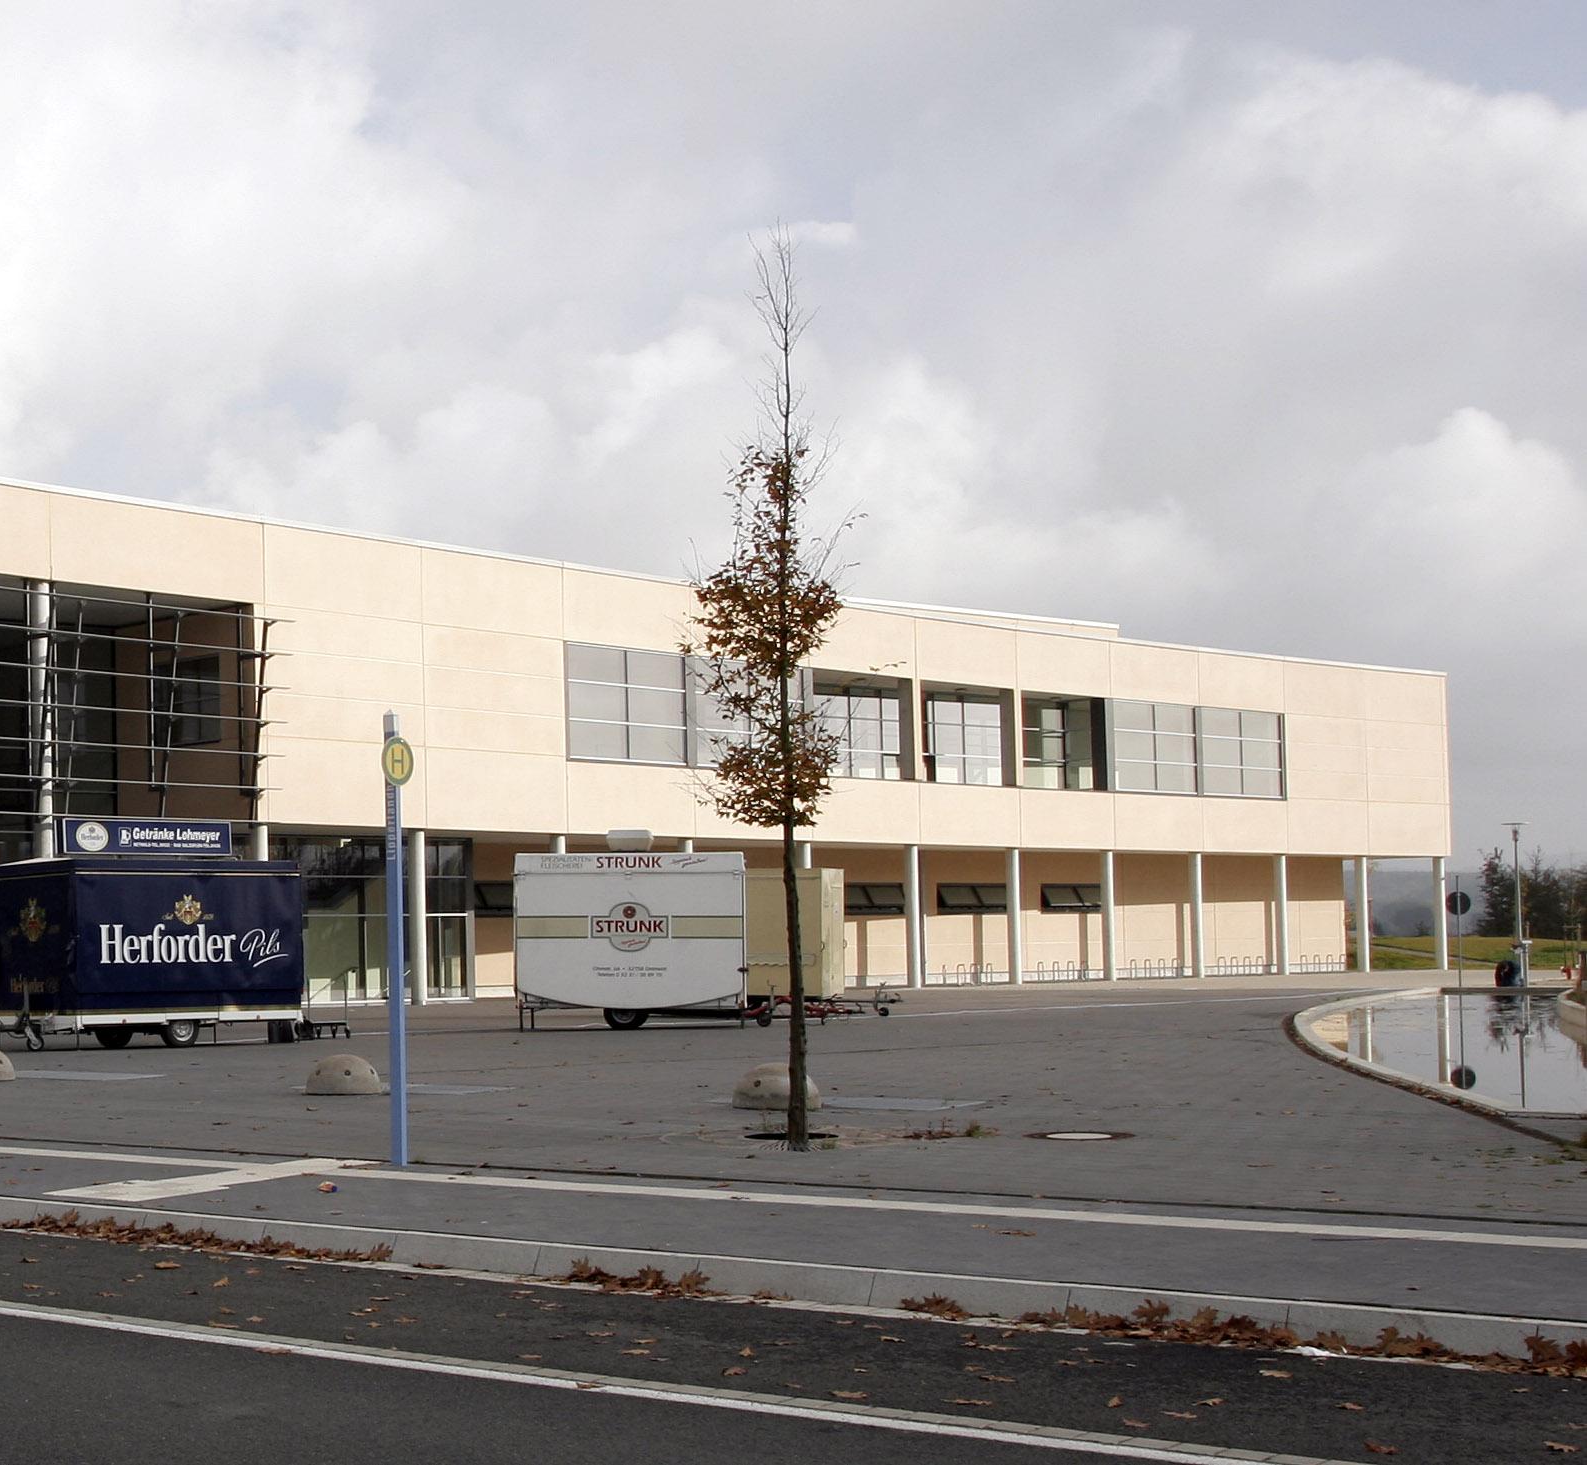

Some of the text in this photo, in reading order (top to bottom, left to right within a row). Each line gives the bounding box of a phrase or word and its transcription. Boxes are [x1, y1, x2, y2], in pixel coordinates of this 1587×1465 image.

[392, 747, 404, 775] H
[132, 827, 221, 843] Getränke Lohmeyer
[596, 856, 662, 869] STRUNK
[595, 920, 664, 933] STRUNK
[99, 923, 284, 964] Herforder Pils
